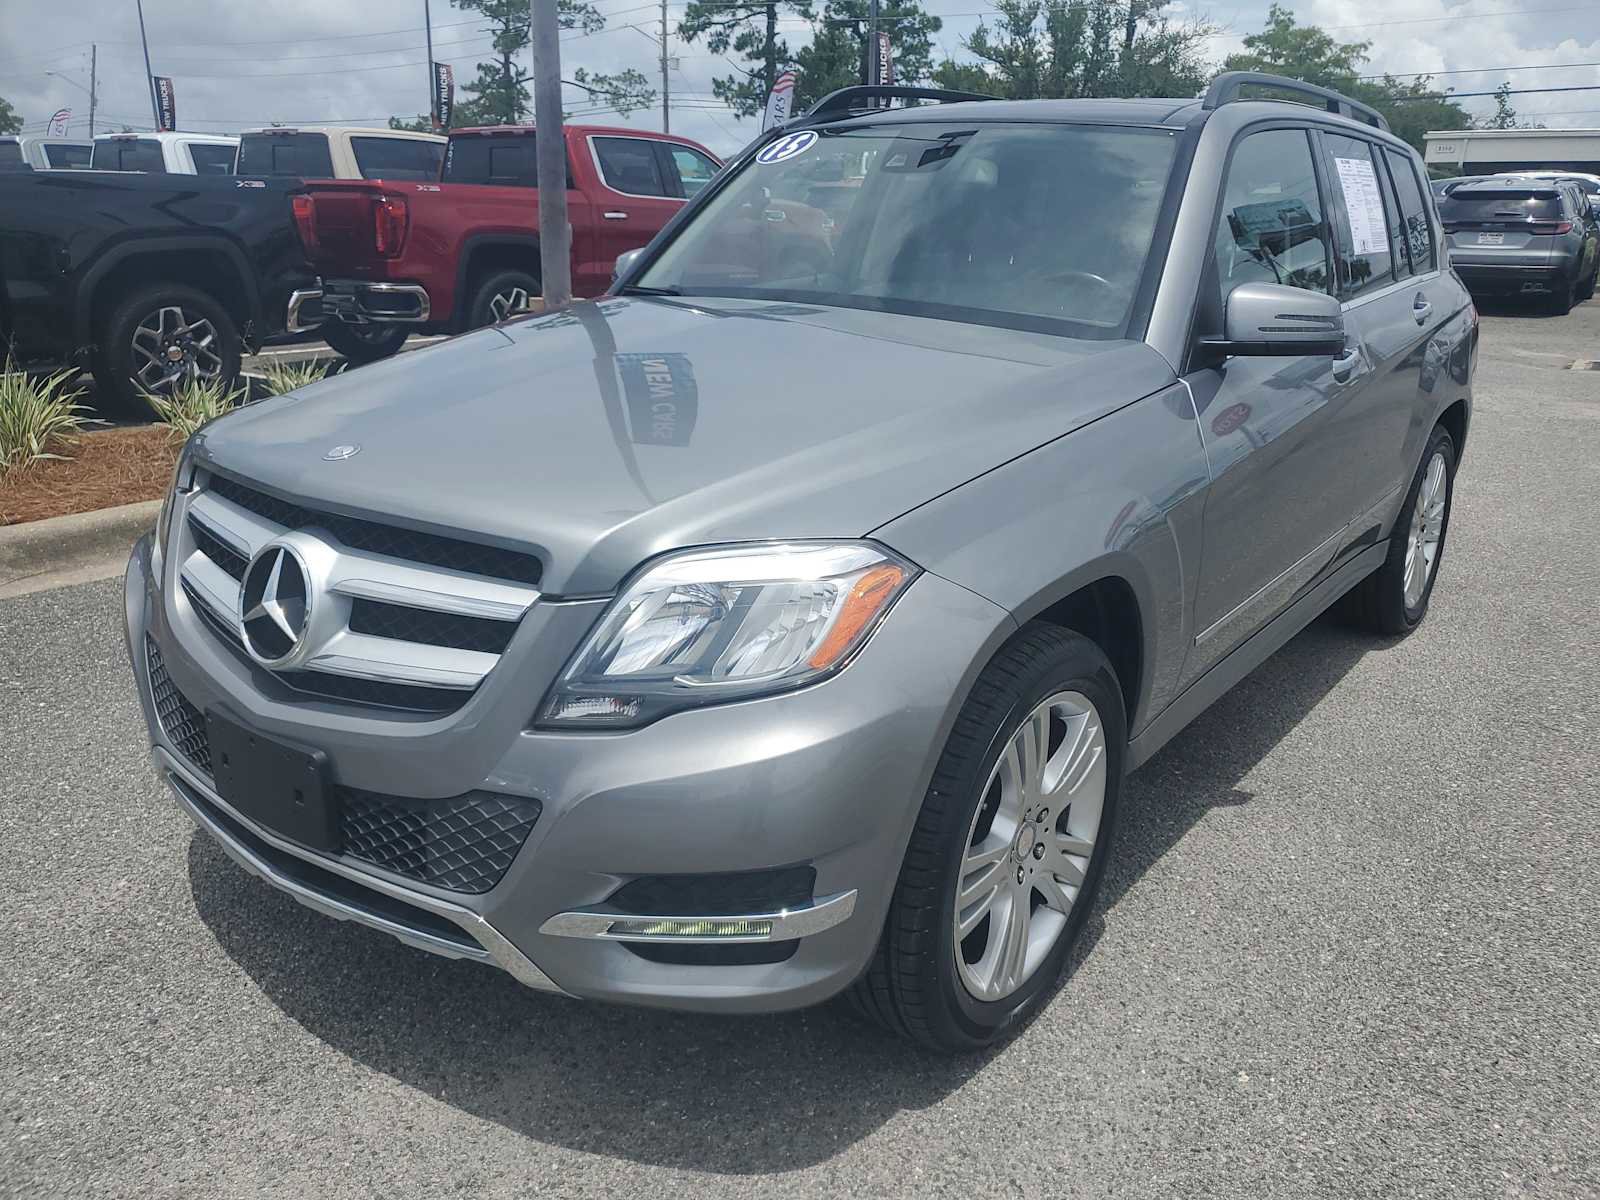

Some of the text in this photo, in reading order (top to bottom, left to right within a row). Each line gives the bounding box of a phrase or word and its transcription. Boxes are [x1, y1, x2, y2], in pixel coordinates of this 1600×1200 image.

[439, 66, 449, 103] TRUCKS
[159, 79, 171, 129] NEW TRUCKS
[773, 95, 785, 125] ARS
